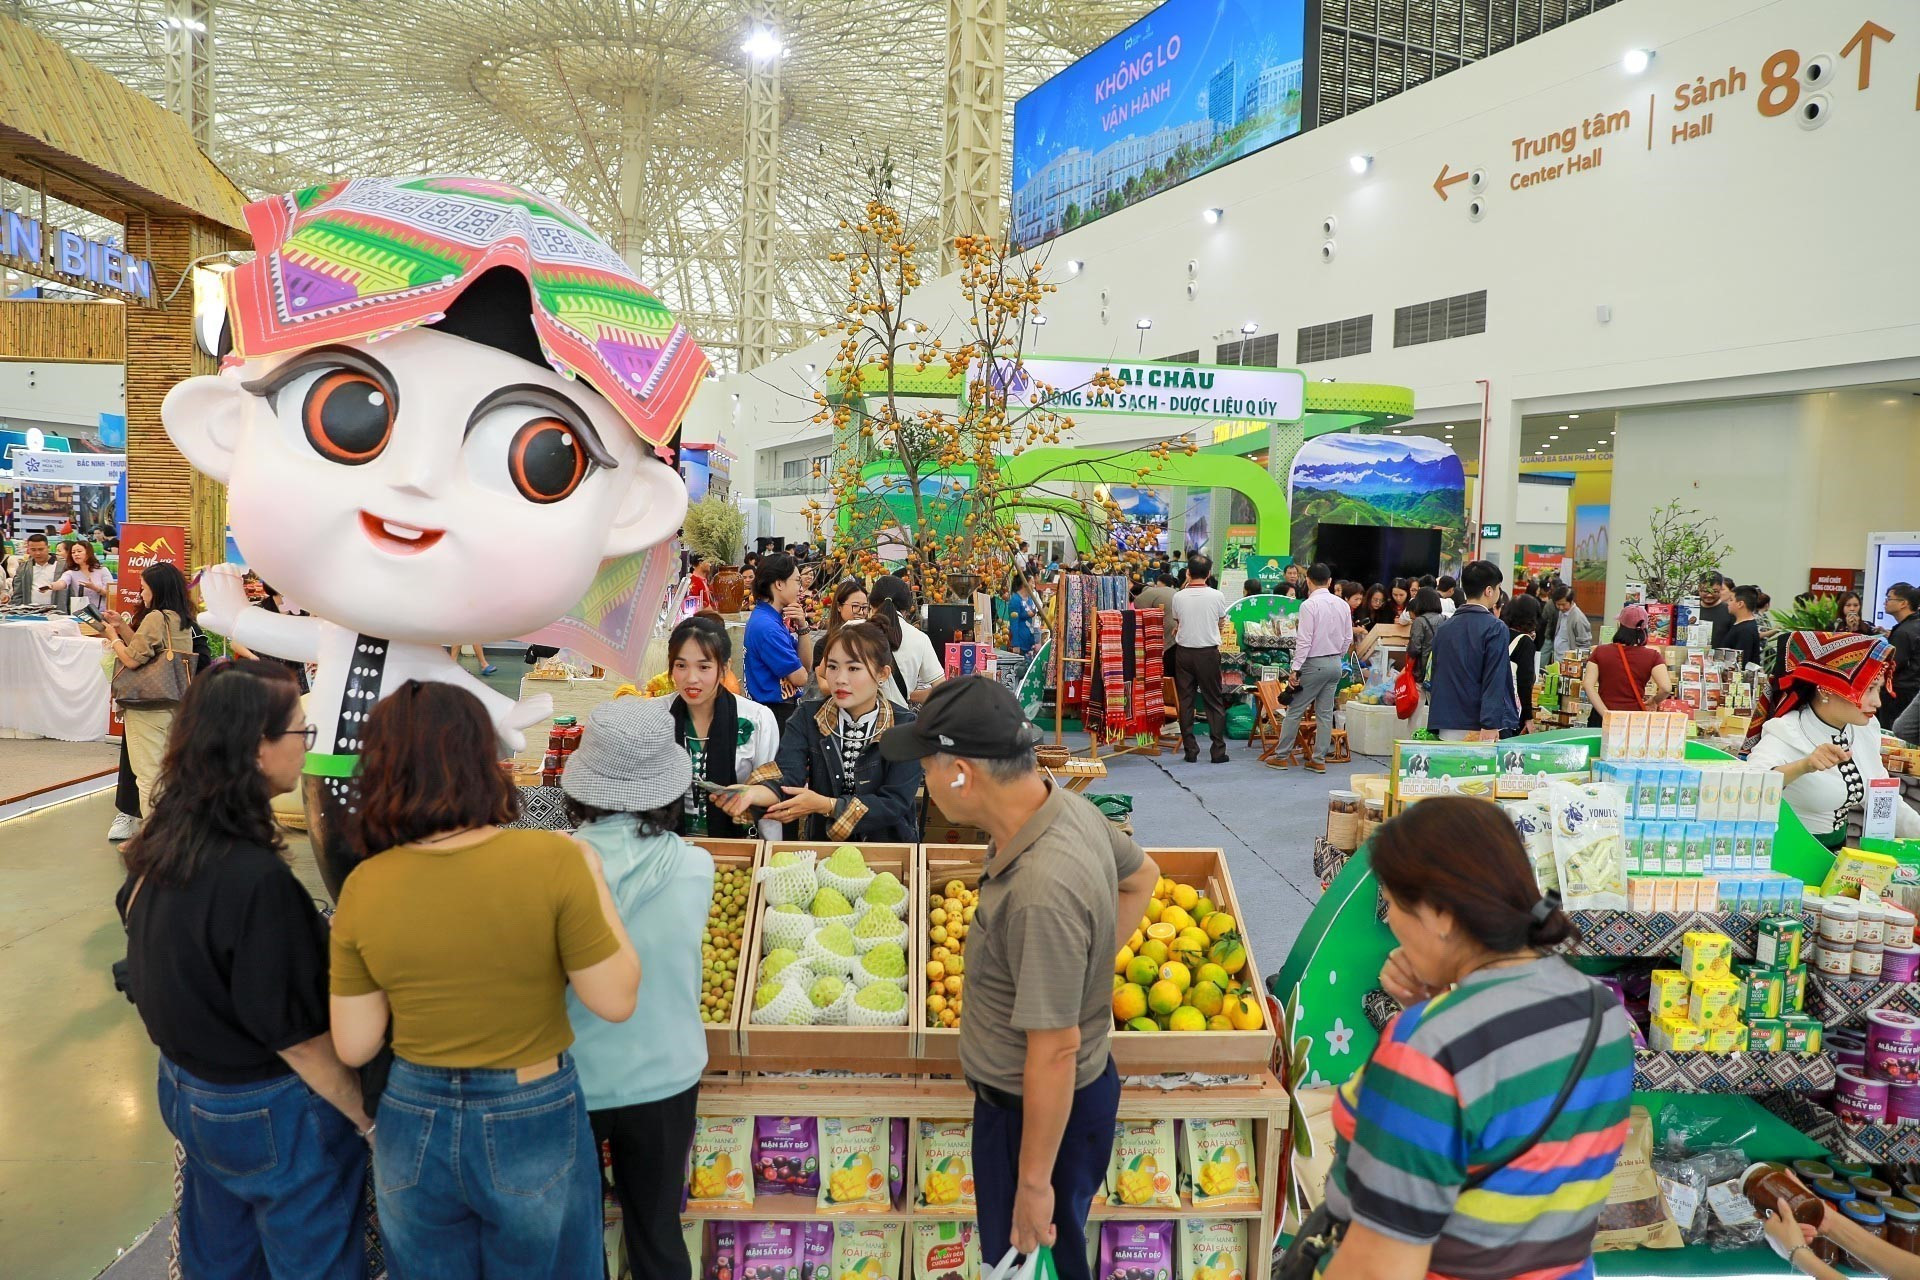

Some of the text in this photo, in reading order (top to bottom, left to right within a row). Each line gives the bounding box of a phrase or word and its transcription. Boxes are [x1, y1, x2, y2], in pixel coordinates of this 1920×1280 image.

[1096, 35, 1180, 104] KHÔNG LO
[1674, 48, 1800, 117] Sảnh 8
[1102, 79, 1171, 133] VẬN HÀNH
[1512, 110, 1630, 162] Trung tâm
[1671, 113, 1712, 144] Hall
[1510, 148, 1602, 190] Center Hall
[55, 235, 150, 300] BIÊN
[1148, 368, 1214, 389] CHÂU
[1119, 394, 1158, 412] SẠCH
[1170, 395, 1210, 415] DƯỢC
[1214, 396, 1242, 416] LIỆU
[761, 1140, 808, 1149] MẬN SẤY DẺO
[830, 1144, 852, 1154] XOÀI
[1198, 1139, 1218, 1148] XOÀI
[746, 1246, 793, 1256] MẬN SẤY DẺO
[842, 1248, 863, 1257] XOÀI
[1115, 1250, 1133, 1258] MẬN
[1134, 1249, 1147, 1258] SẤY
[1193, 1243, 1214, 1252] XOÀI
